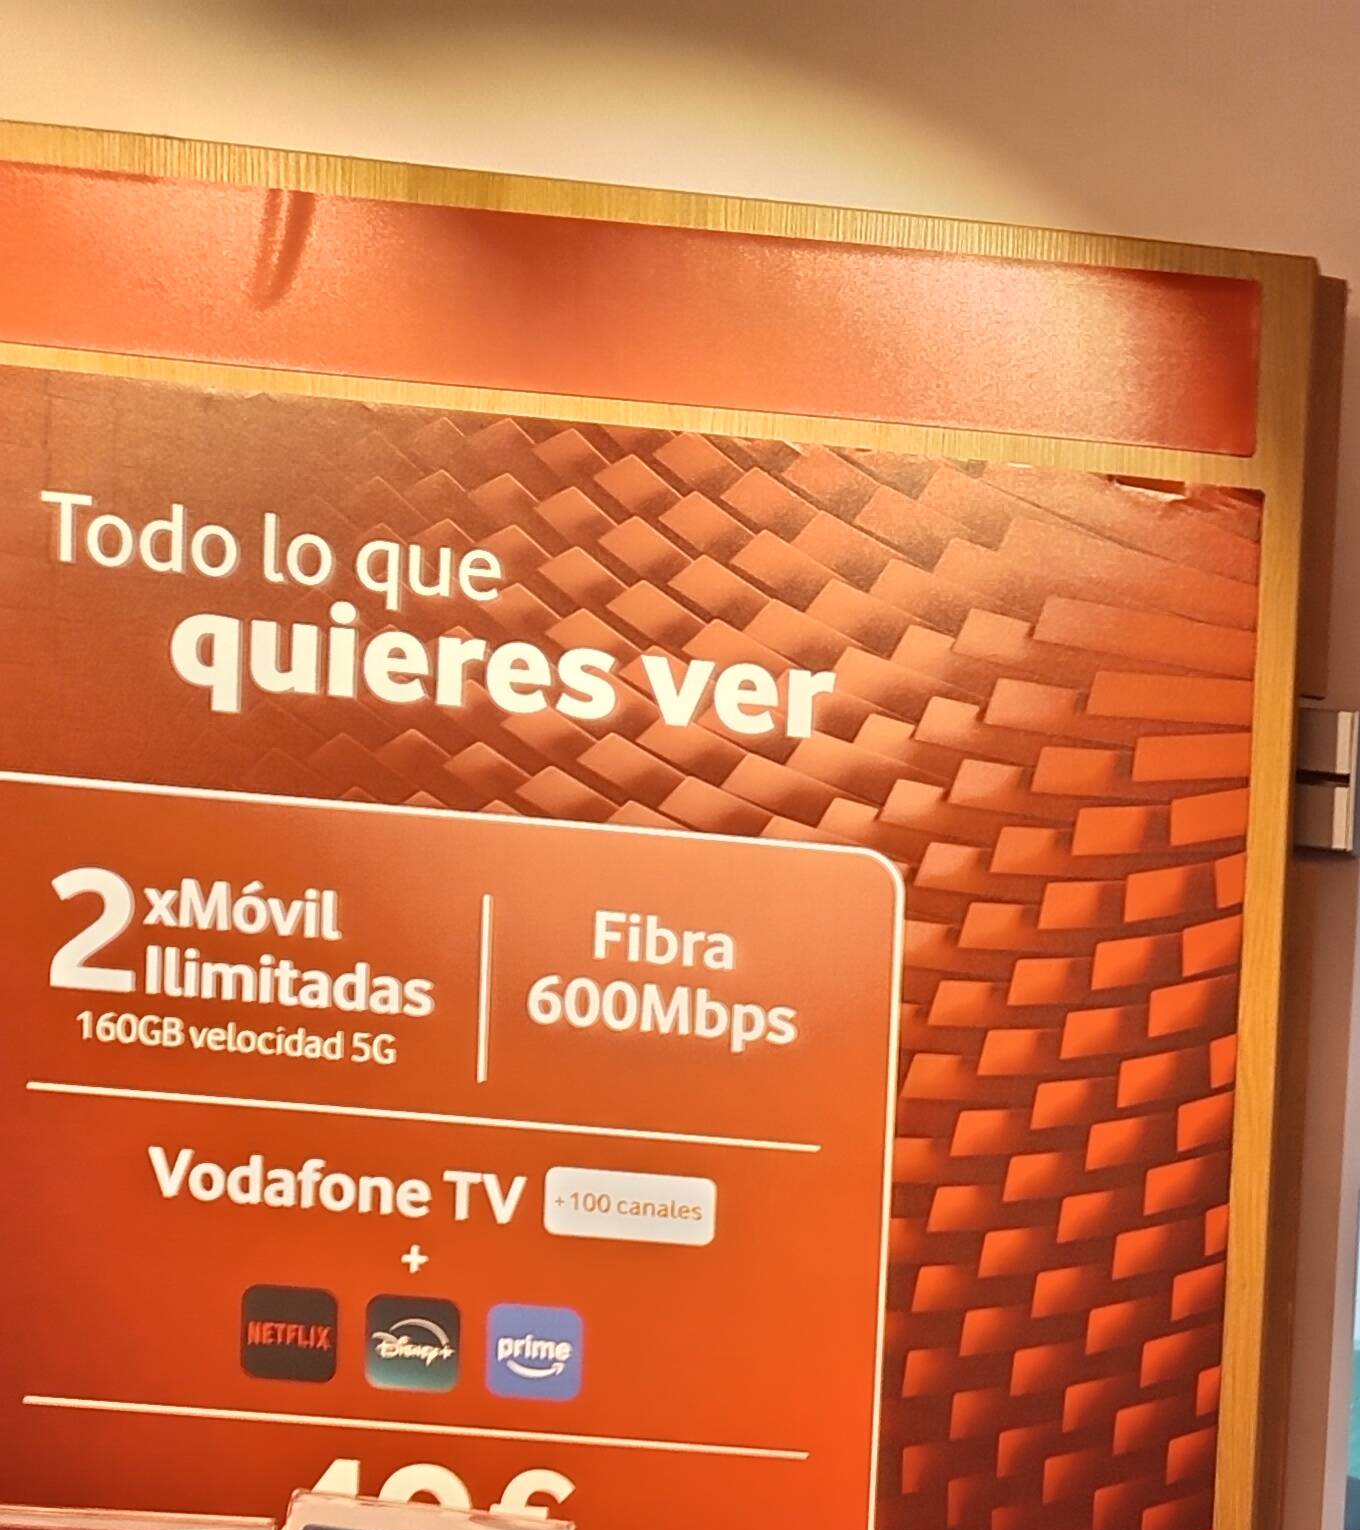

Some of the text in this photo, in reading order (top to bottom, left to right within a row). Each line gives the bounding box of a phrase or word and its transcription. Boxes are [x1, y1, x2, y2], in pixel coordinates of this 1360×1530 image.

[41, 489, 504, 611] Todo lo que
[170, 602, 836, 740] quieres ver
[49, 866, 135, 993] 2
[143, 878, 342, 941] xMóvil
[593, 911, 736, 971] Fibra
[144, 946, 435, 1019] Ilimitadas
[526, 973, 798, 1054] 600Mbps
[75, 1010, 397, 1066] 160GB velocidad 5G
[148, 1146, 526, 1224] Vodafone TV
[617, 1194, 703, 1222] canales
[247, 1320, 331, 1351] NETFLIX
[370, 1328, 454, 1367] Disney+
[497, 1334, 571, 1365] prime
